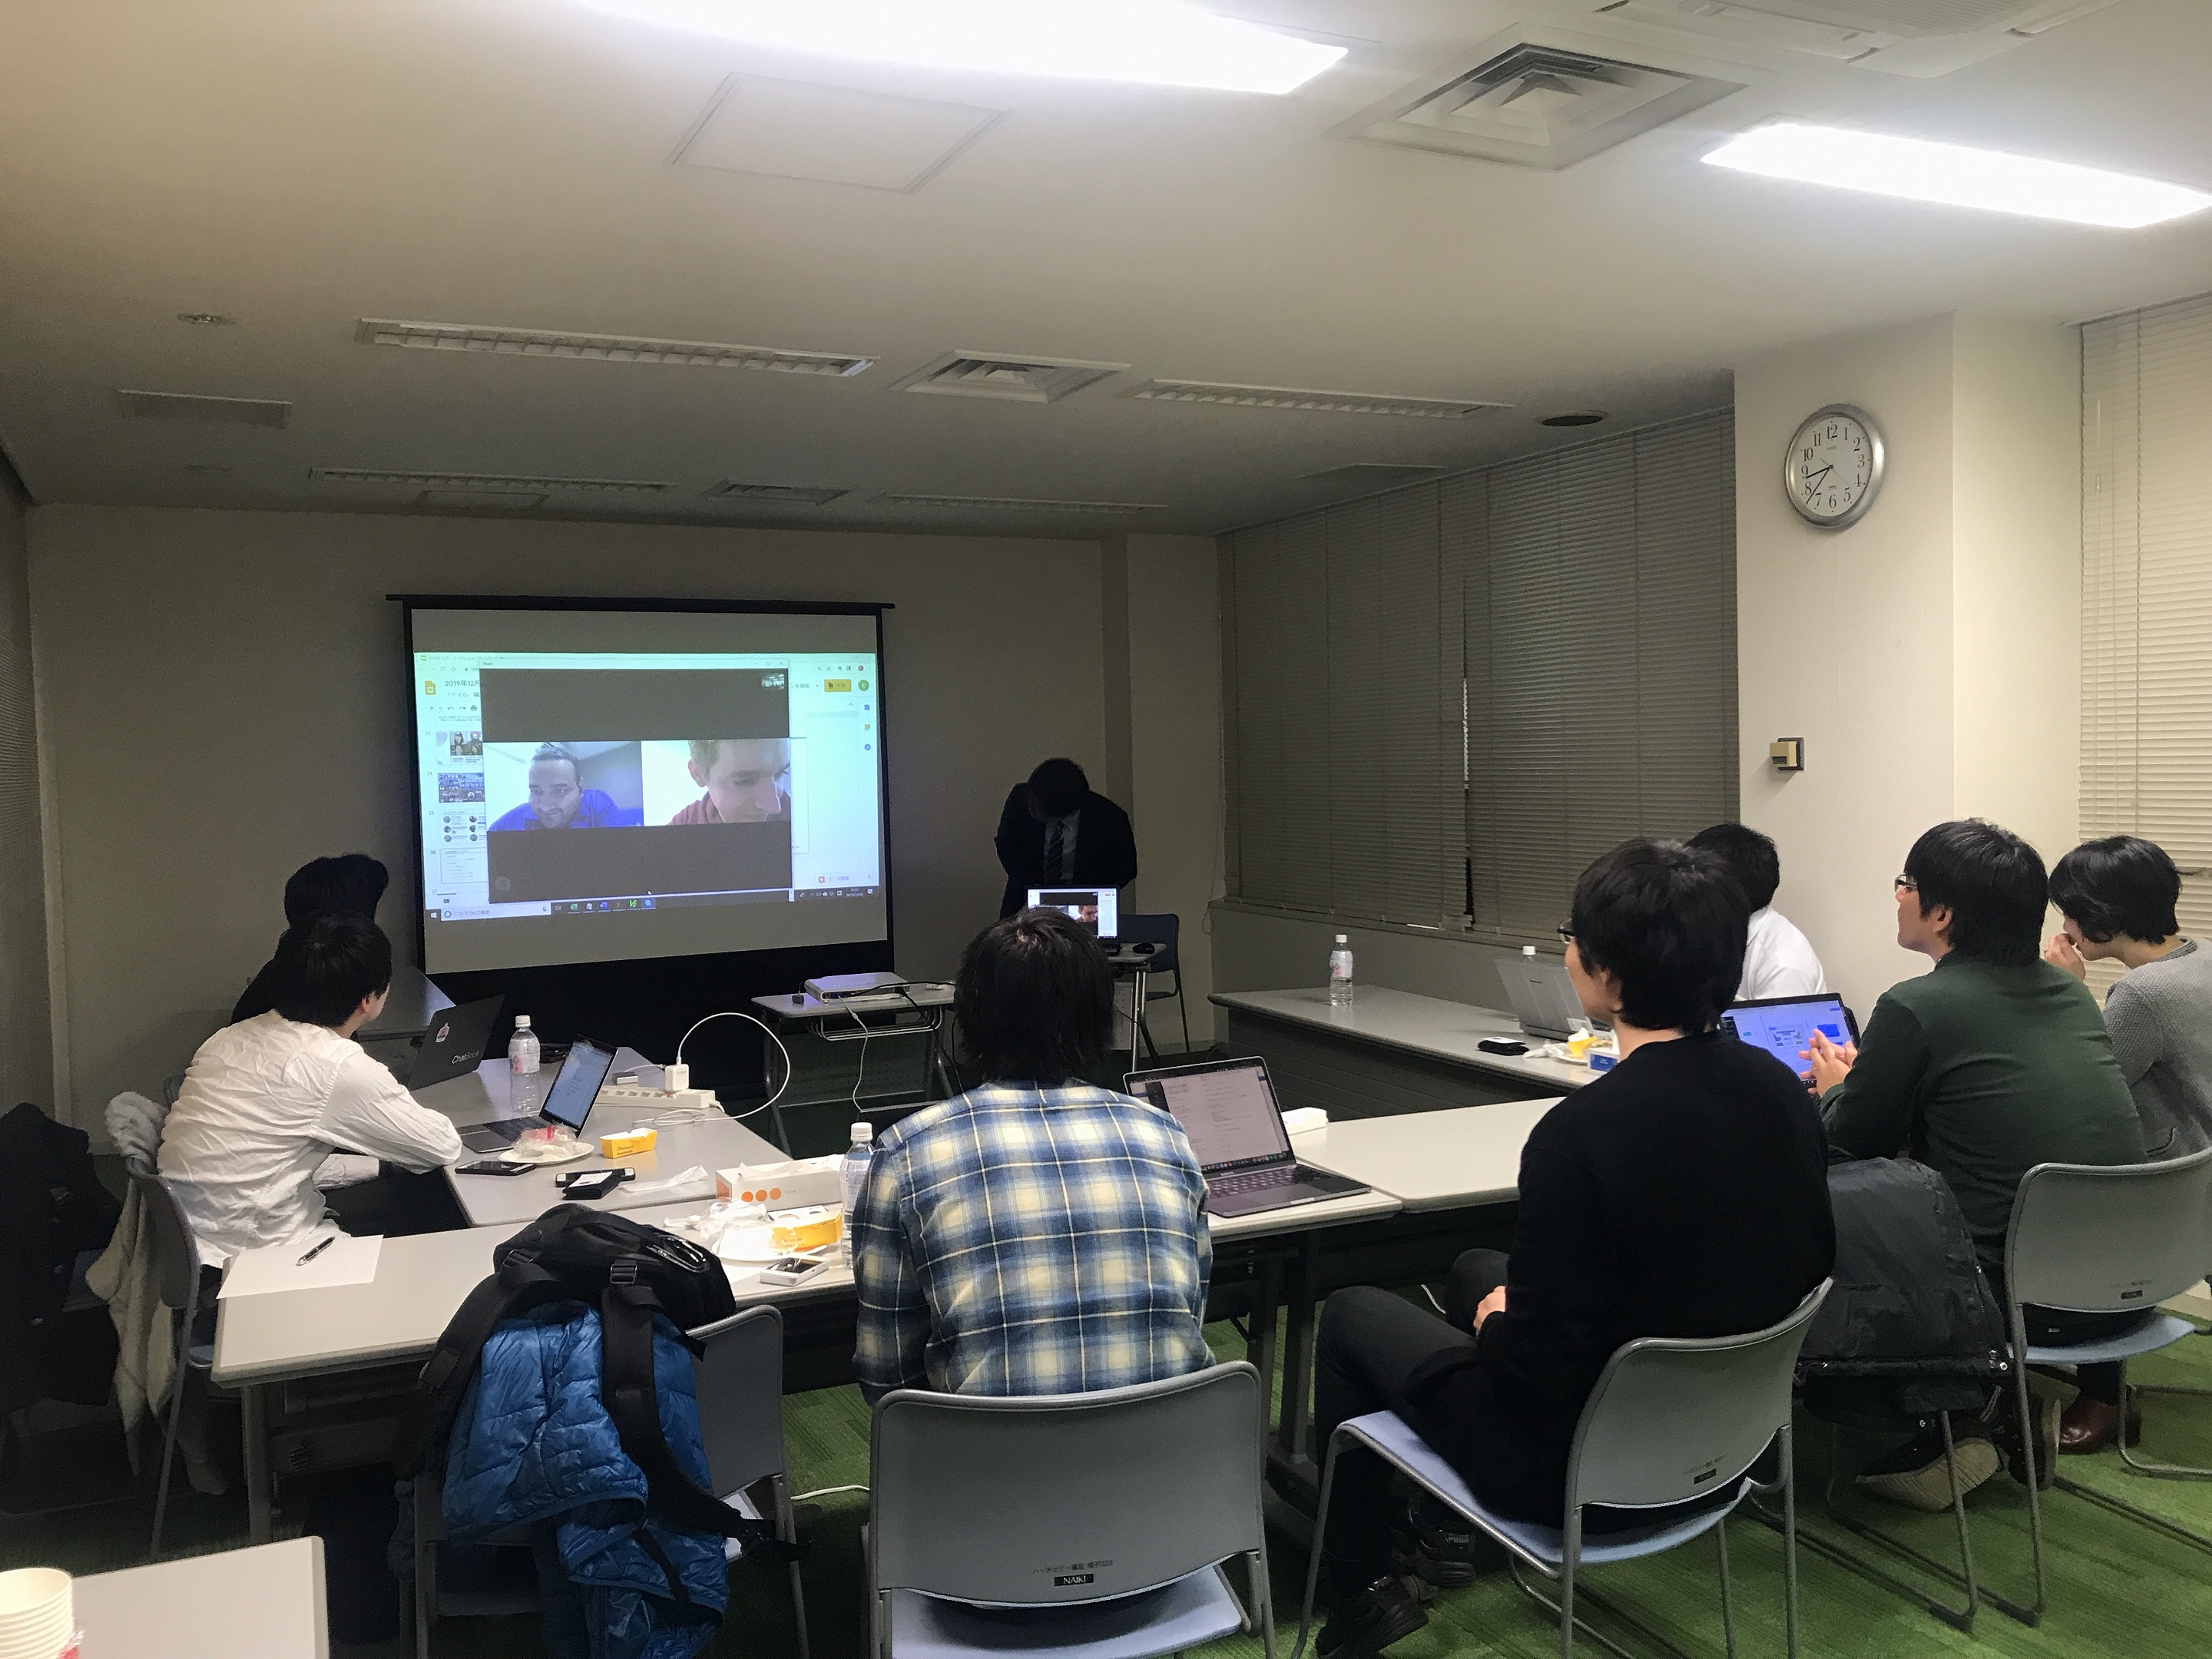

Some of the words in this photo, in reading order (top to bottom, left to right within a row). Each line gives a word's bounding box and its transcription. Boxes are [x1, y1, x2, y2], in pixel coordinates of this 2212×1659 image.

[1826, 424, 1838, 439] 12
[1845, 427, 1849, 439] 1
[1813, 433, 1821, 446] 11
[1853, 437, 1861, 452] 2
[1803, 447, 1813, 462] 10
[1857, 454, 1865, 469] 3
[1801, 465, 1809, 479] 9
[1855, 473, 1861, 487] 4
[1805, 481, 1812, 496] 8
[1843, 487, 1851, 502] 5
[1815, 492, 1822, 507] 7
[1829, 494, 1836, 508] 6
[1063, 1575, 1086, 1584] NAIKI
